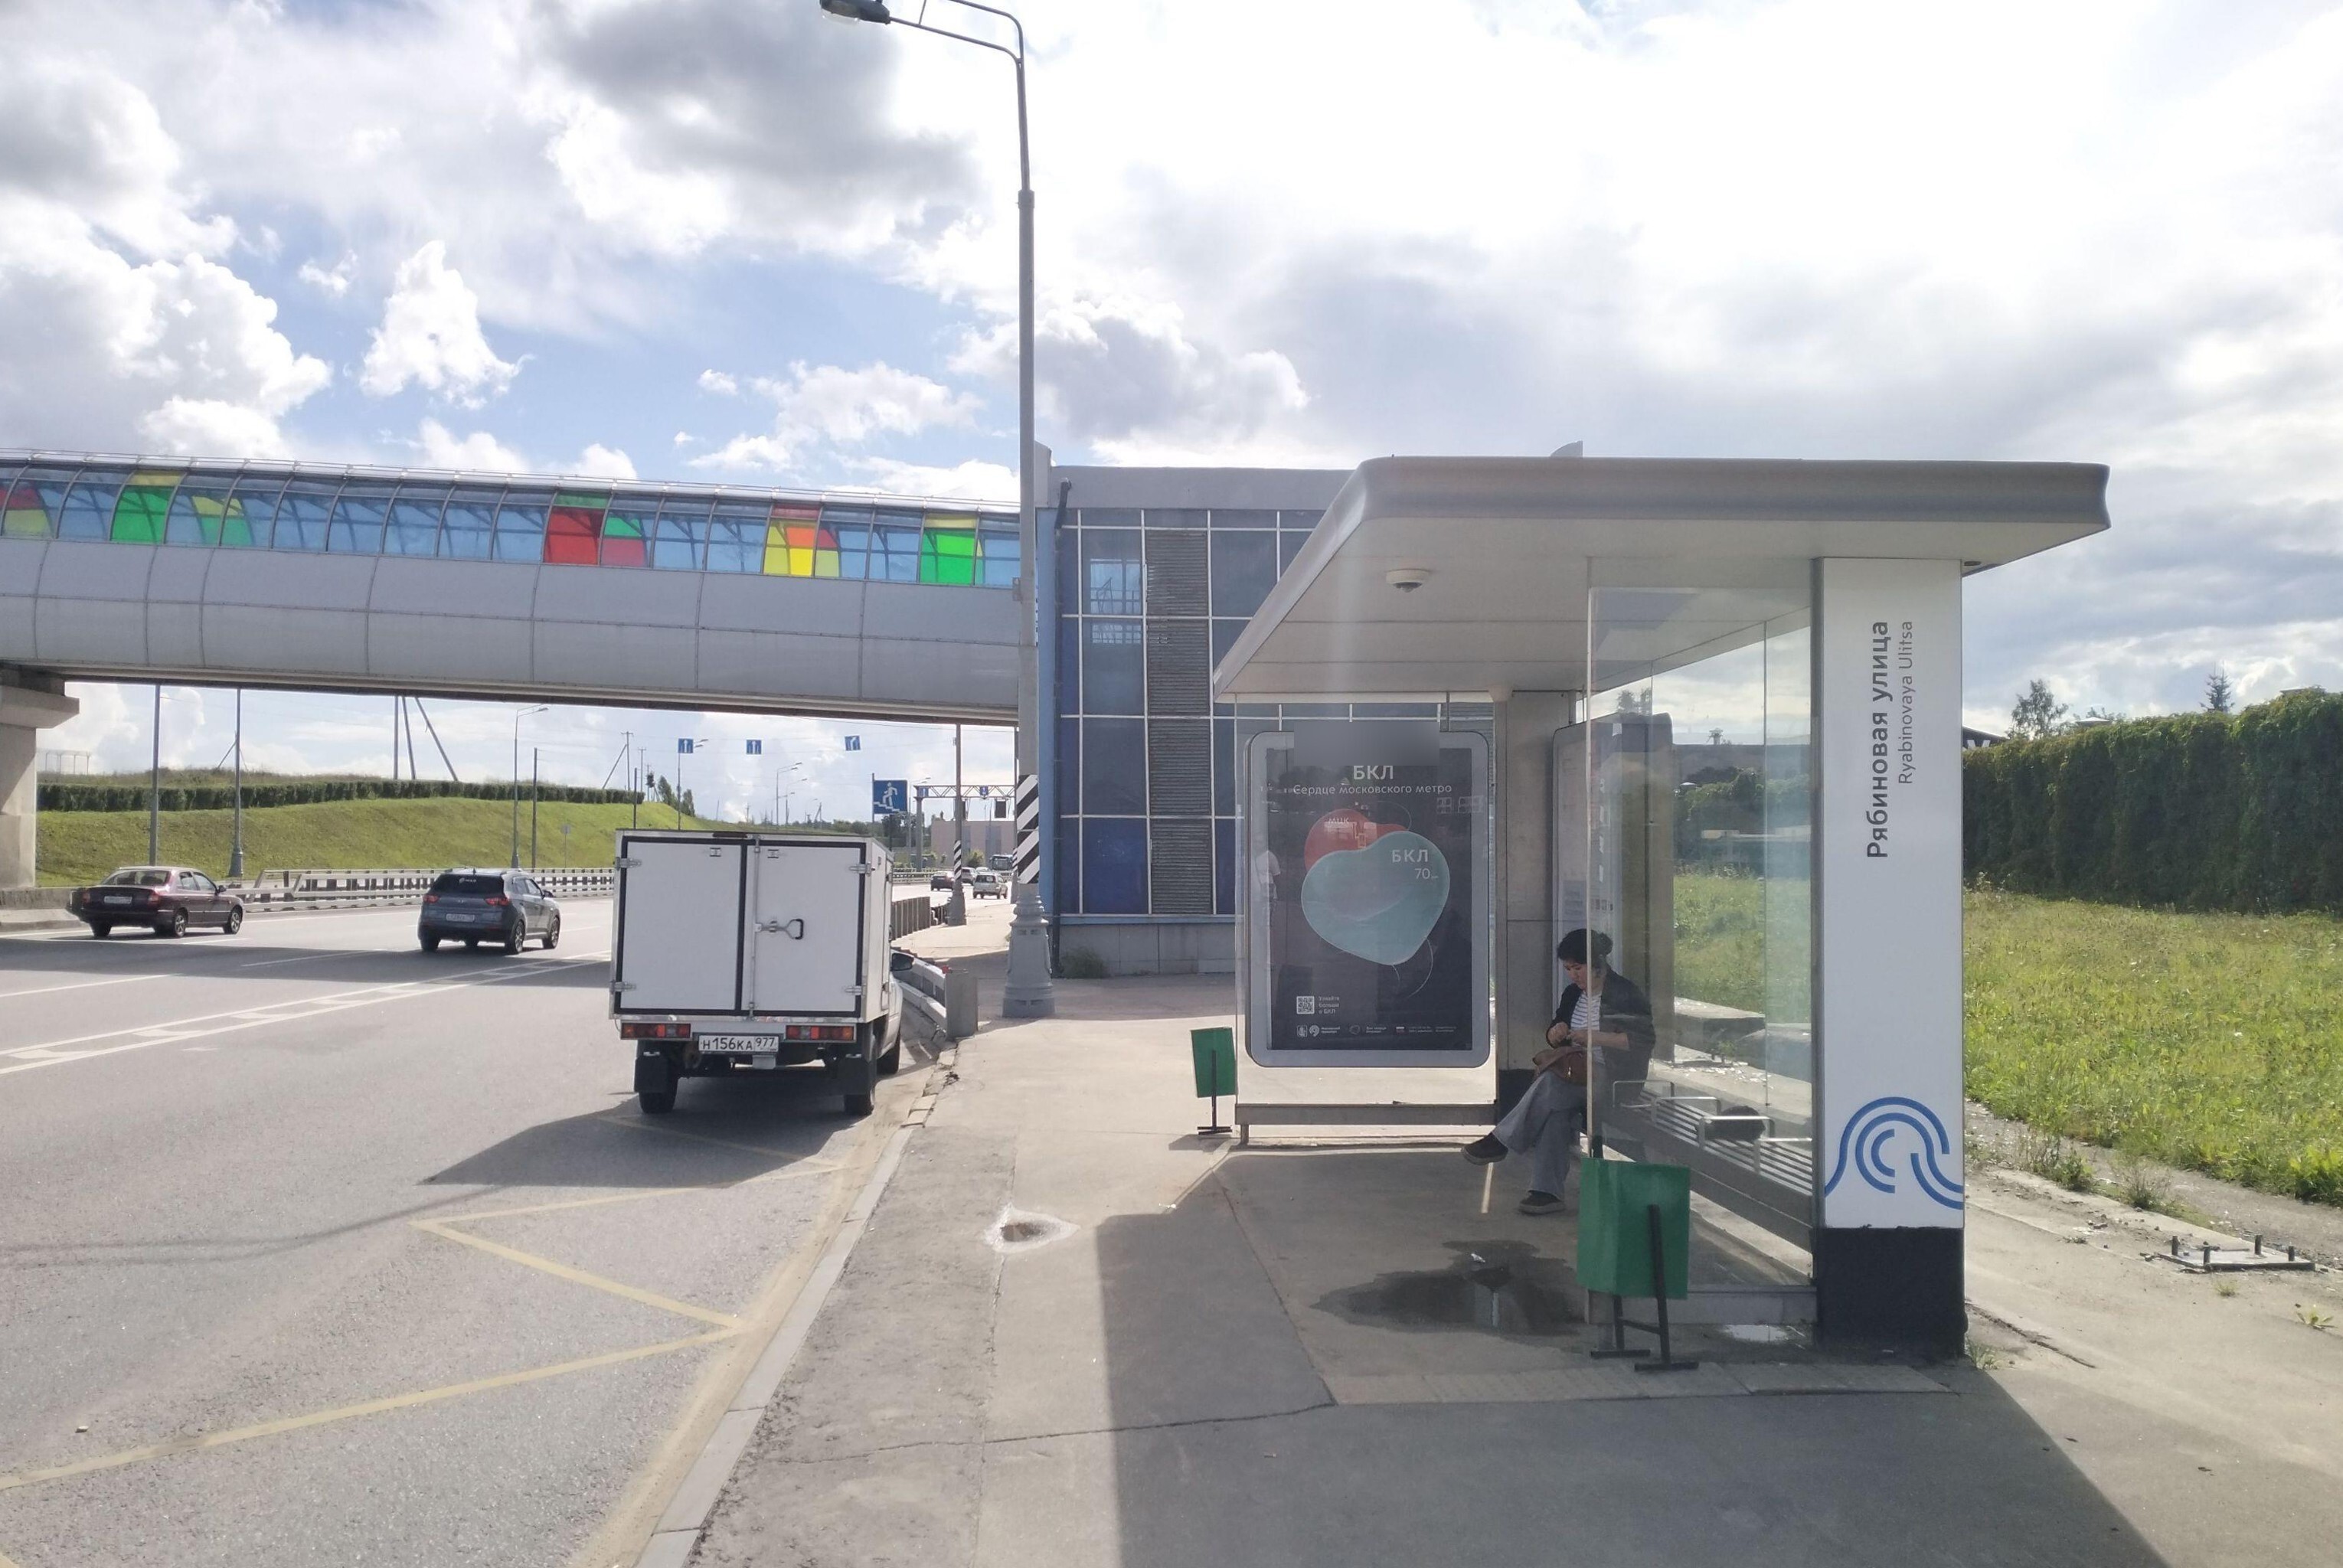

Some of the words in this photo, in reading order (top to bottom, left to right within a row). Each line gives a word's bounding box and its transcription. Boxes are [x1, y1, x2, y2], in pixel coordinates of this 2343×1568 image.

[1898, 621, 1913, 668] Ulitsa
[1872, 621, 1893, 701] улица
[1897, 675, 1916, 784] Ryabinovaya
[1353, 765, 1394, 780] БКЛ
[1866, 713, 1888, 858] Рябиновая
[1293, 784, 1335, 795] Сердце
[1339, 783, 1412, 795] московского
[1416, 784, 1452, 794] метро
[1391, 849, 1429, 863] БКЛ
[1414, 867, 1430, 880] 70
